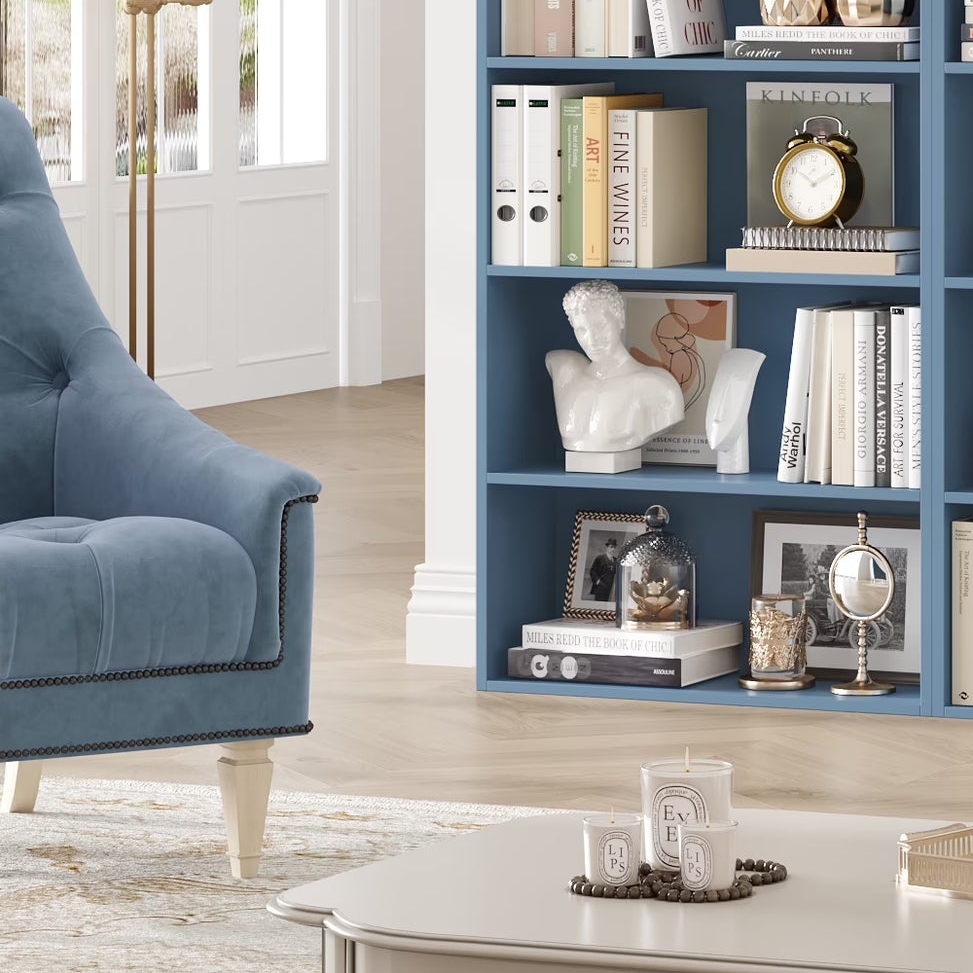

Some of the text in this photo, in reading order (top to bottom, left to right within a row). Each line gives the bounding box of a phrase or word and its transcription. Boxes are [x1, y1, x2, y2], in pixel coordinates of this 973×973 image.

[684, 21, 718, 46] CHIC
[731, 41, 782, 58] Cartier
[742, 30, 773, 39] MILES
[776, 30, 803, 39] REDD
[806, 30, 826, 39] THE
[829, 31, 857, 39] BOOK
[760, 89, 873, 107] KINFOLK
[586, 137, 600, 164] ART
[613, 132, 630, 174] FINE
[613, 183, 630, 245] WINES
[912, 322, 921, 375] STORIES
[858, 340, 867, 459] GIORGIO ARMANI
[876, 325, 886, 473] DONATELLA VERSACE
[780, 426, 792, 463] Andy
[786, 421, 802, 469] Warhol
[893, 381, 904, 477] ART FOR SURVIVAL
[526, 631, 668, 653] MILES REDD THE BOOK OF CHIC
